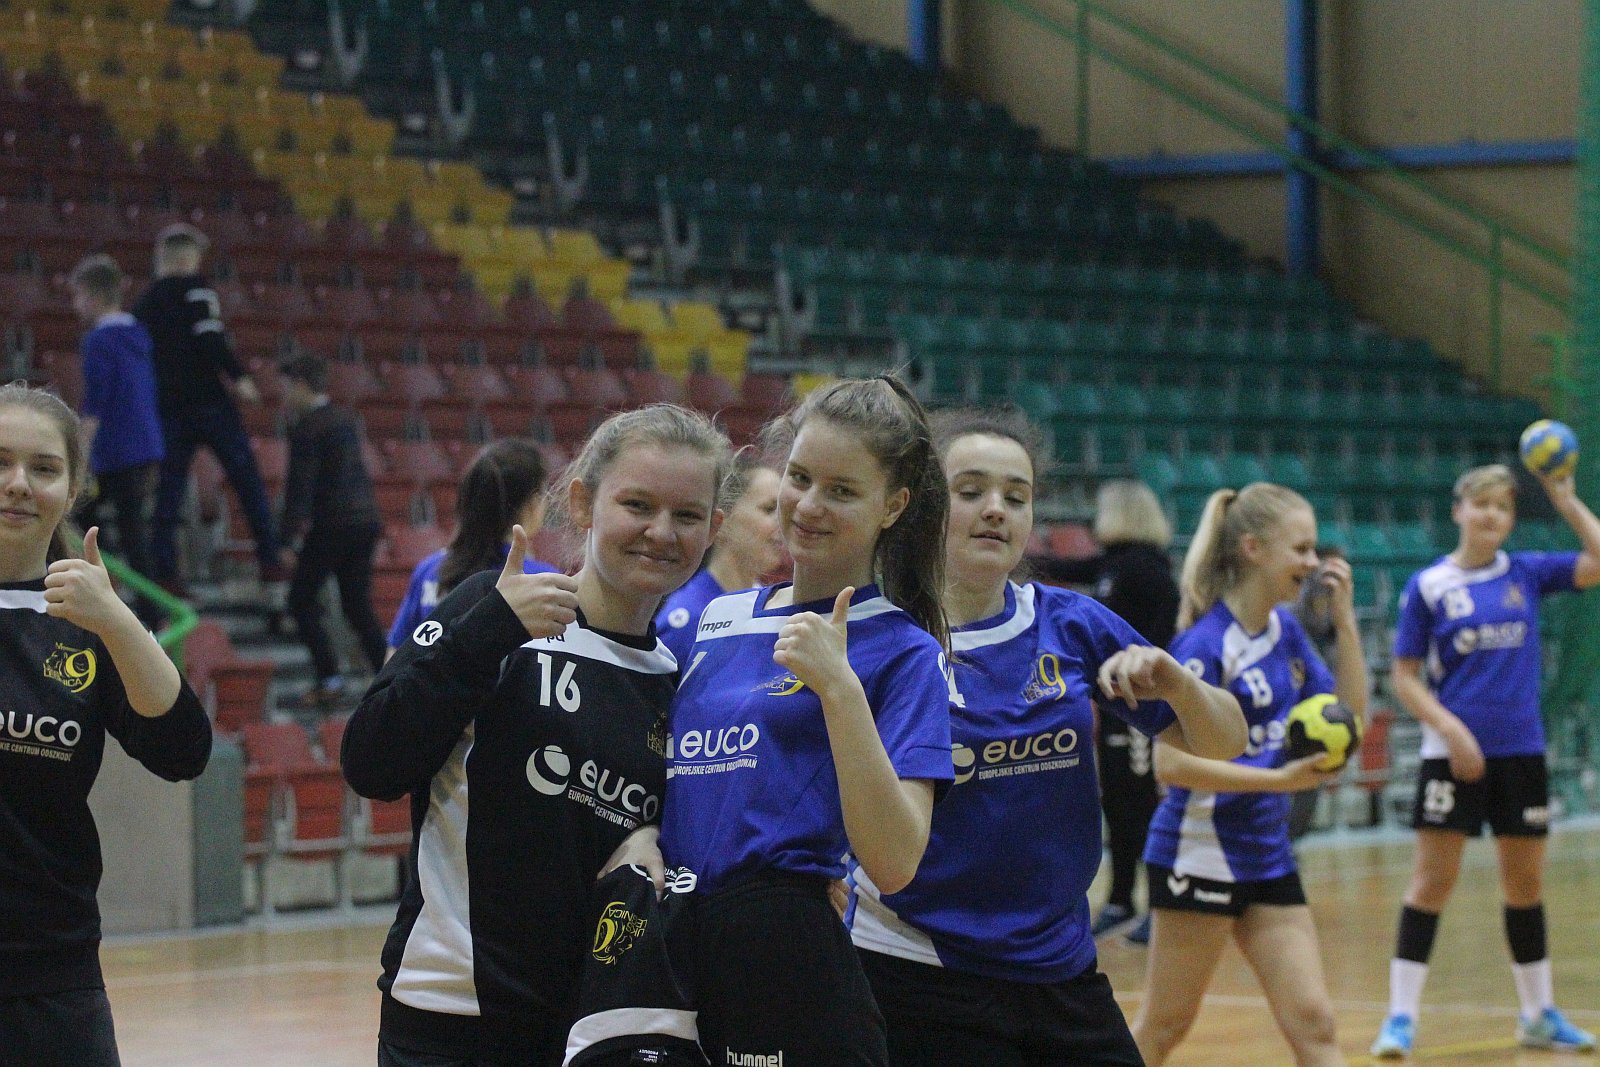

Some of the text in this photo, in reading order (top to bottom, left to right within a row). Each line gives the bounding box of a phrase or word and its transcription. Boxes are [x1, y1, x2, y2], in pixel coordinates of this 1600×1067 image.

[537, 652, 581, 713] 16
[0, 710, 82, 747] uco
[679, 723, 760, 759] euco
[982, 728, 1078, 764] euco
[10, 744, 40, 757] CENTRUM
[979, 766, 1014, 780] EUROPEJSKIE
[1013, 763, 1040, 775] CENTRUM
[580, 759, 659, 822] euco
[594, 804, 624, 826] CENTRUM
[726, 1045, 783, 1067] hummel
